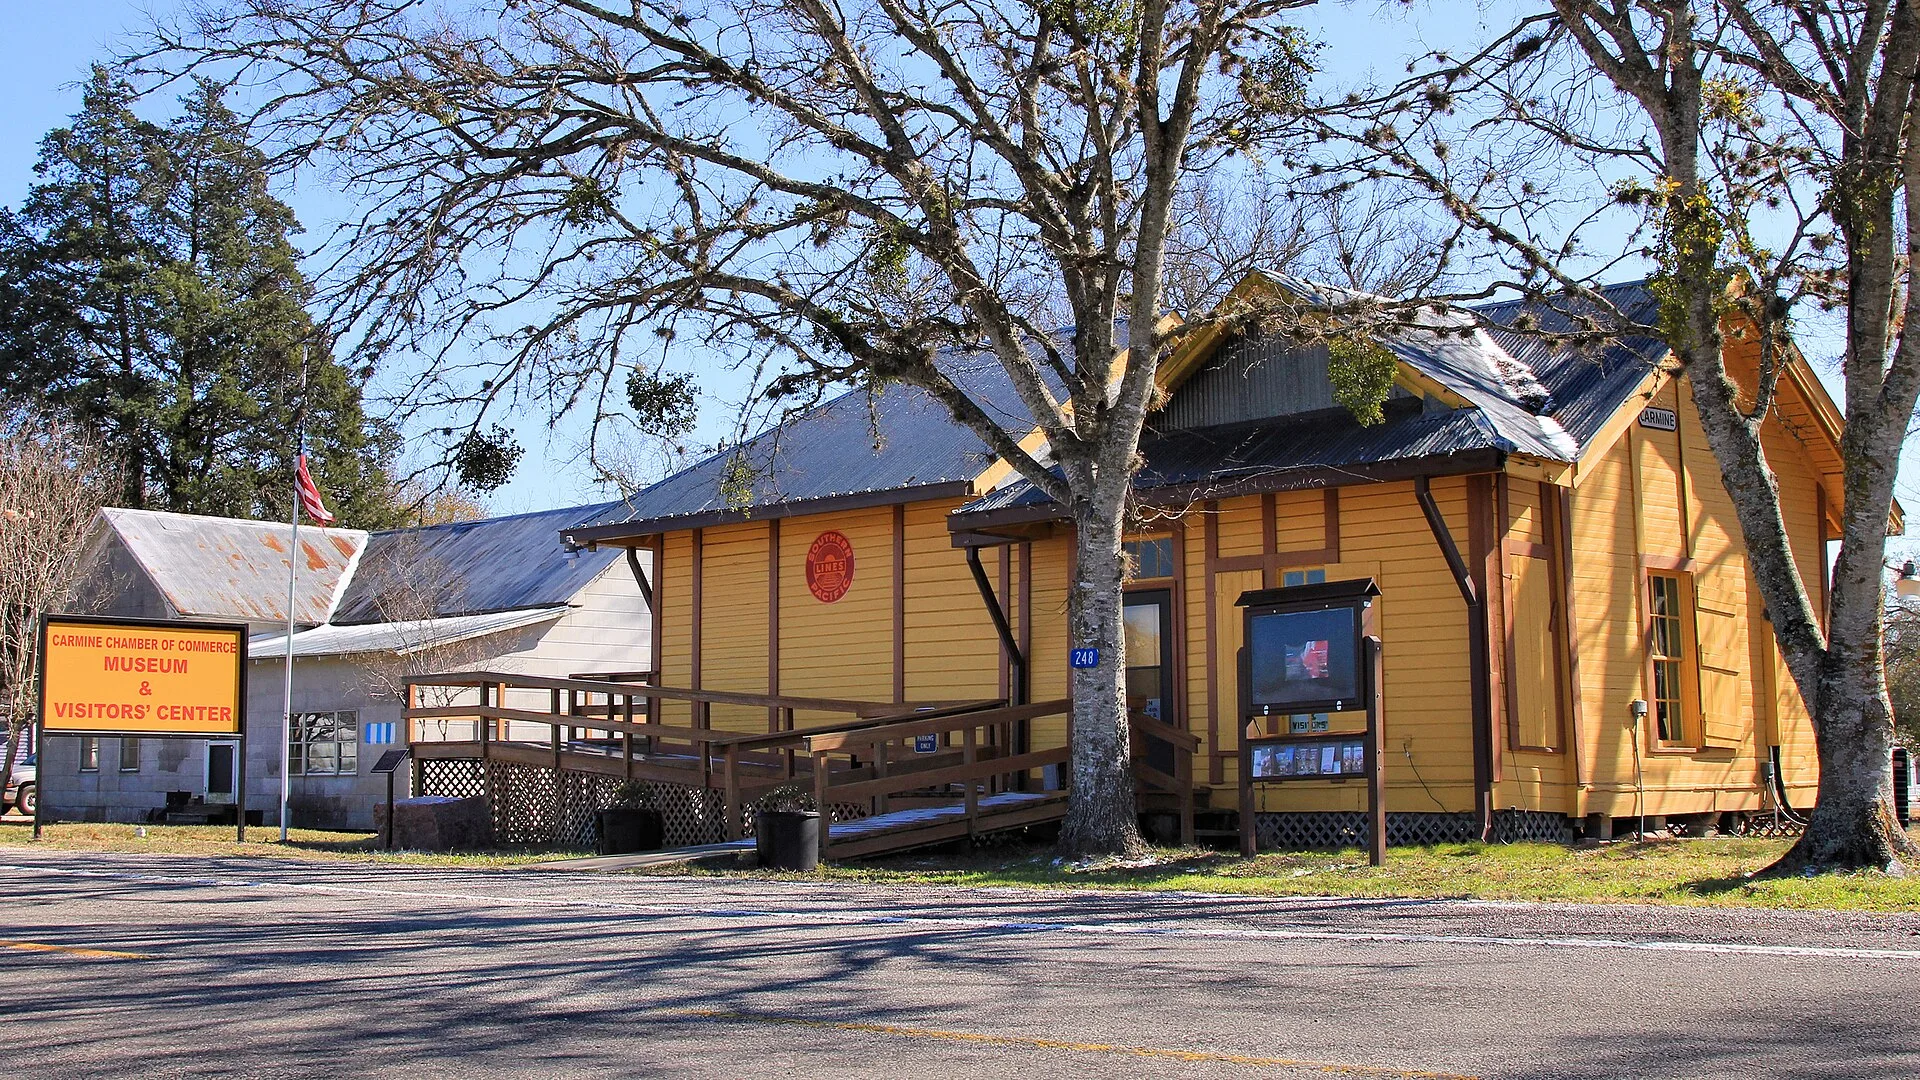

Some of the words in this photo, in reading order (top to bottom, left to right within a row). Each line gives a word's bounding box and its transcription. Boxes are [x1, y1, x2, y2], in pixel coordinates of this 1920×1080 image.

[1640, 410, 1675, 427] CARMINE
[808, 533, 852, 561] SOUTHERN
[816, 562, 844, 573] LINES
[811, 578, 850, 601] PACIFIC
[52, 635, 102, 648] CARMINE
[106, 637, 158, 650] CHAMBER
[161, 639, 175, 651] OF
[178, 640, 237, 653] COMMERCE
[104, 656, 188, 673] MUSEUM
[1075, 651, 1094, 665] 248
[138, 681, 152, 696] &
[54, 702, 150, 719] VISITORS'
[156, 705, 232, 721] CENTER
